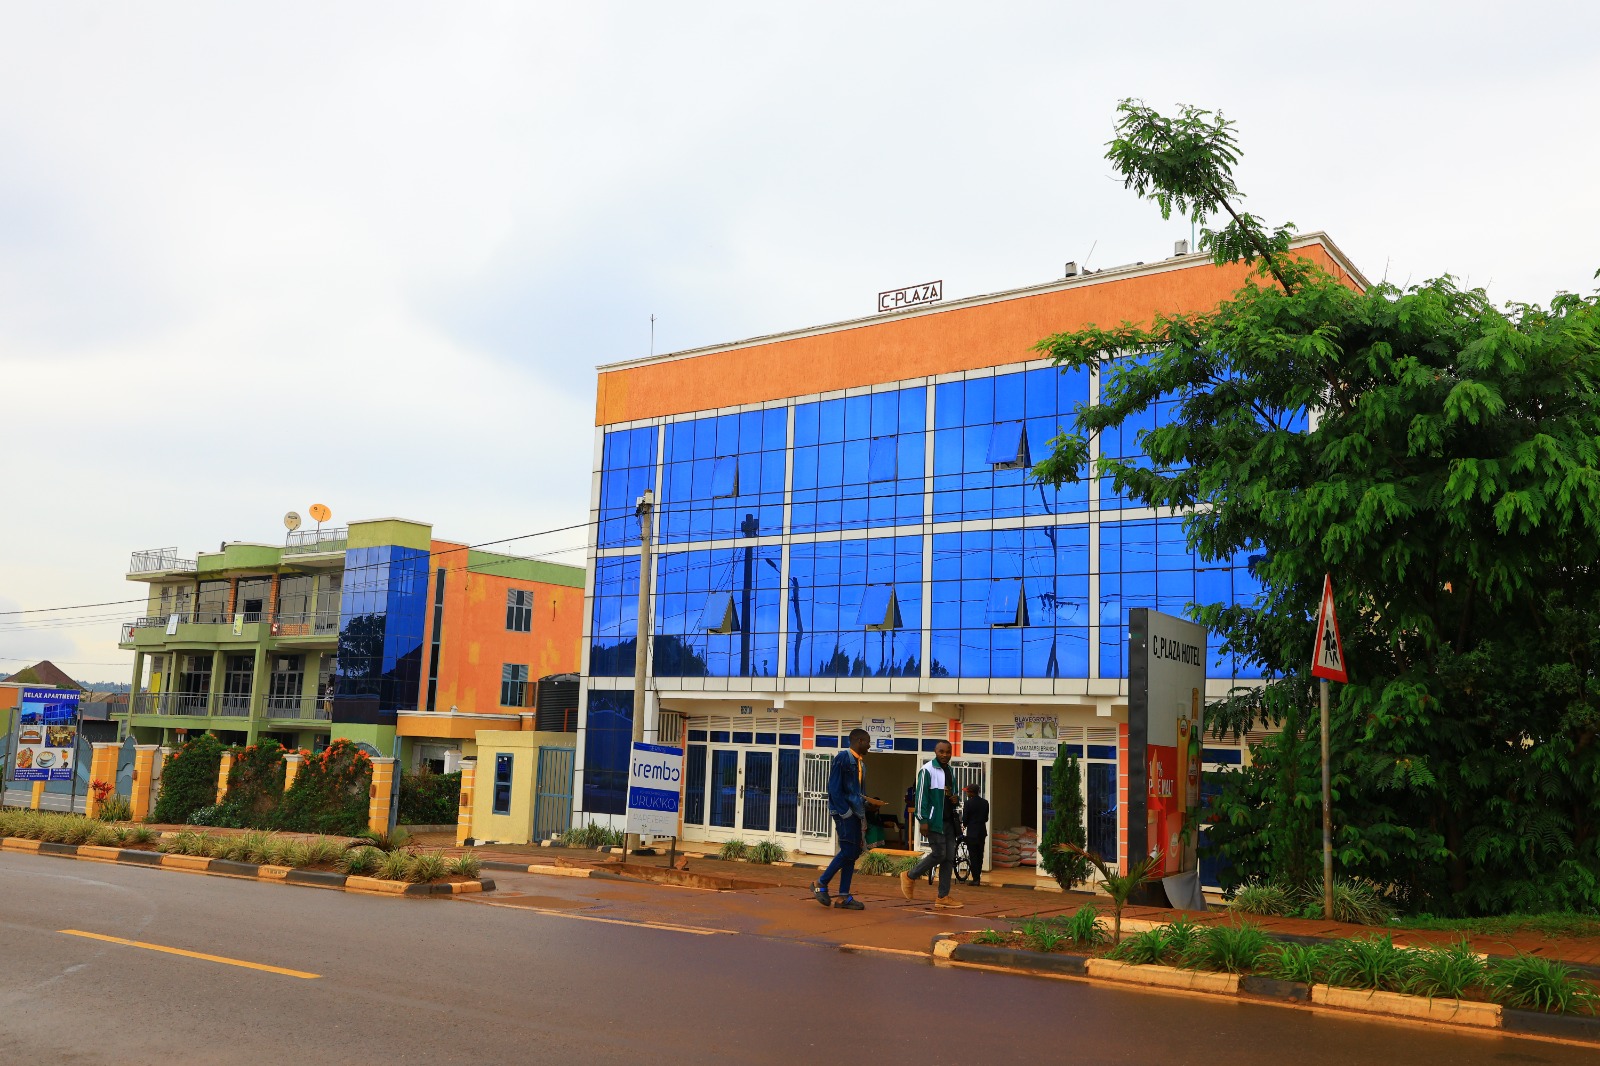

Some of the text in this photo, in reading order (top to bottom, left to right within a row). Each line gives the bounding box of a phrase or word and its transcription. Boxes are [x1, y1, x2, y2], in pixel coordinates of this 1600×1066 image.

[881, 284, 938, 308] C-PLAZA
[1181, 643, 1201, 667] HOTEL
[23, 691, 80, 700] RELAX APARTMENTS
[865, 722, 892, 733] irembo
[633, 757, 680, 782] irembo
